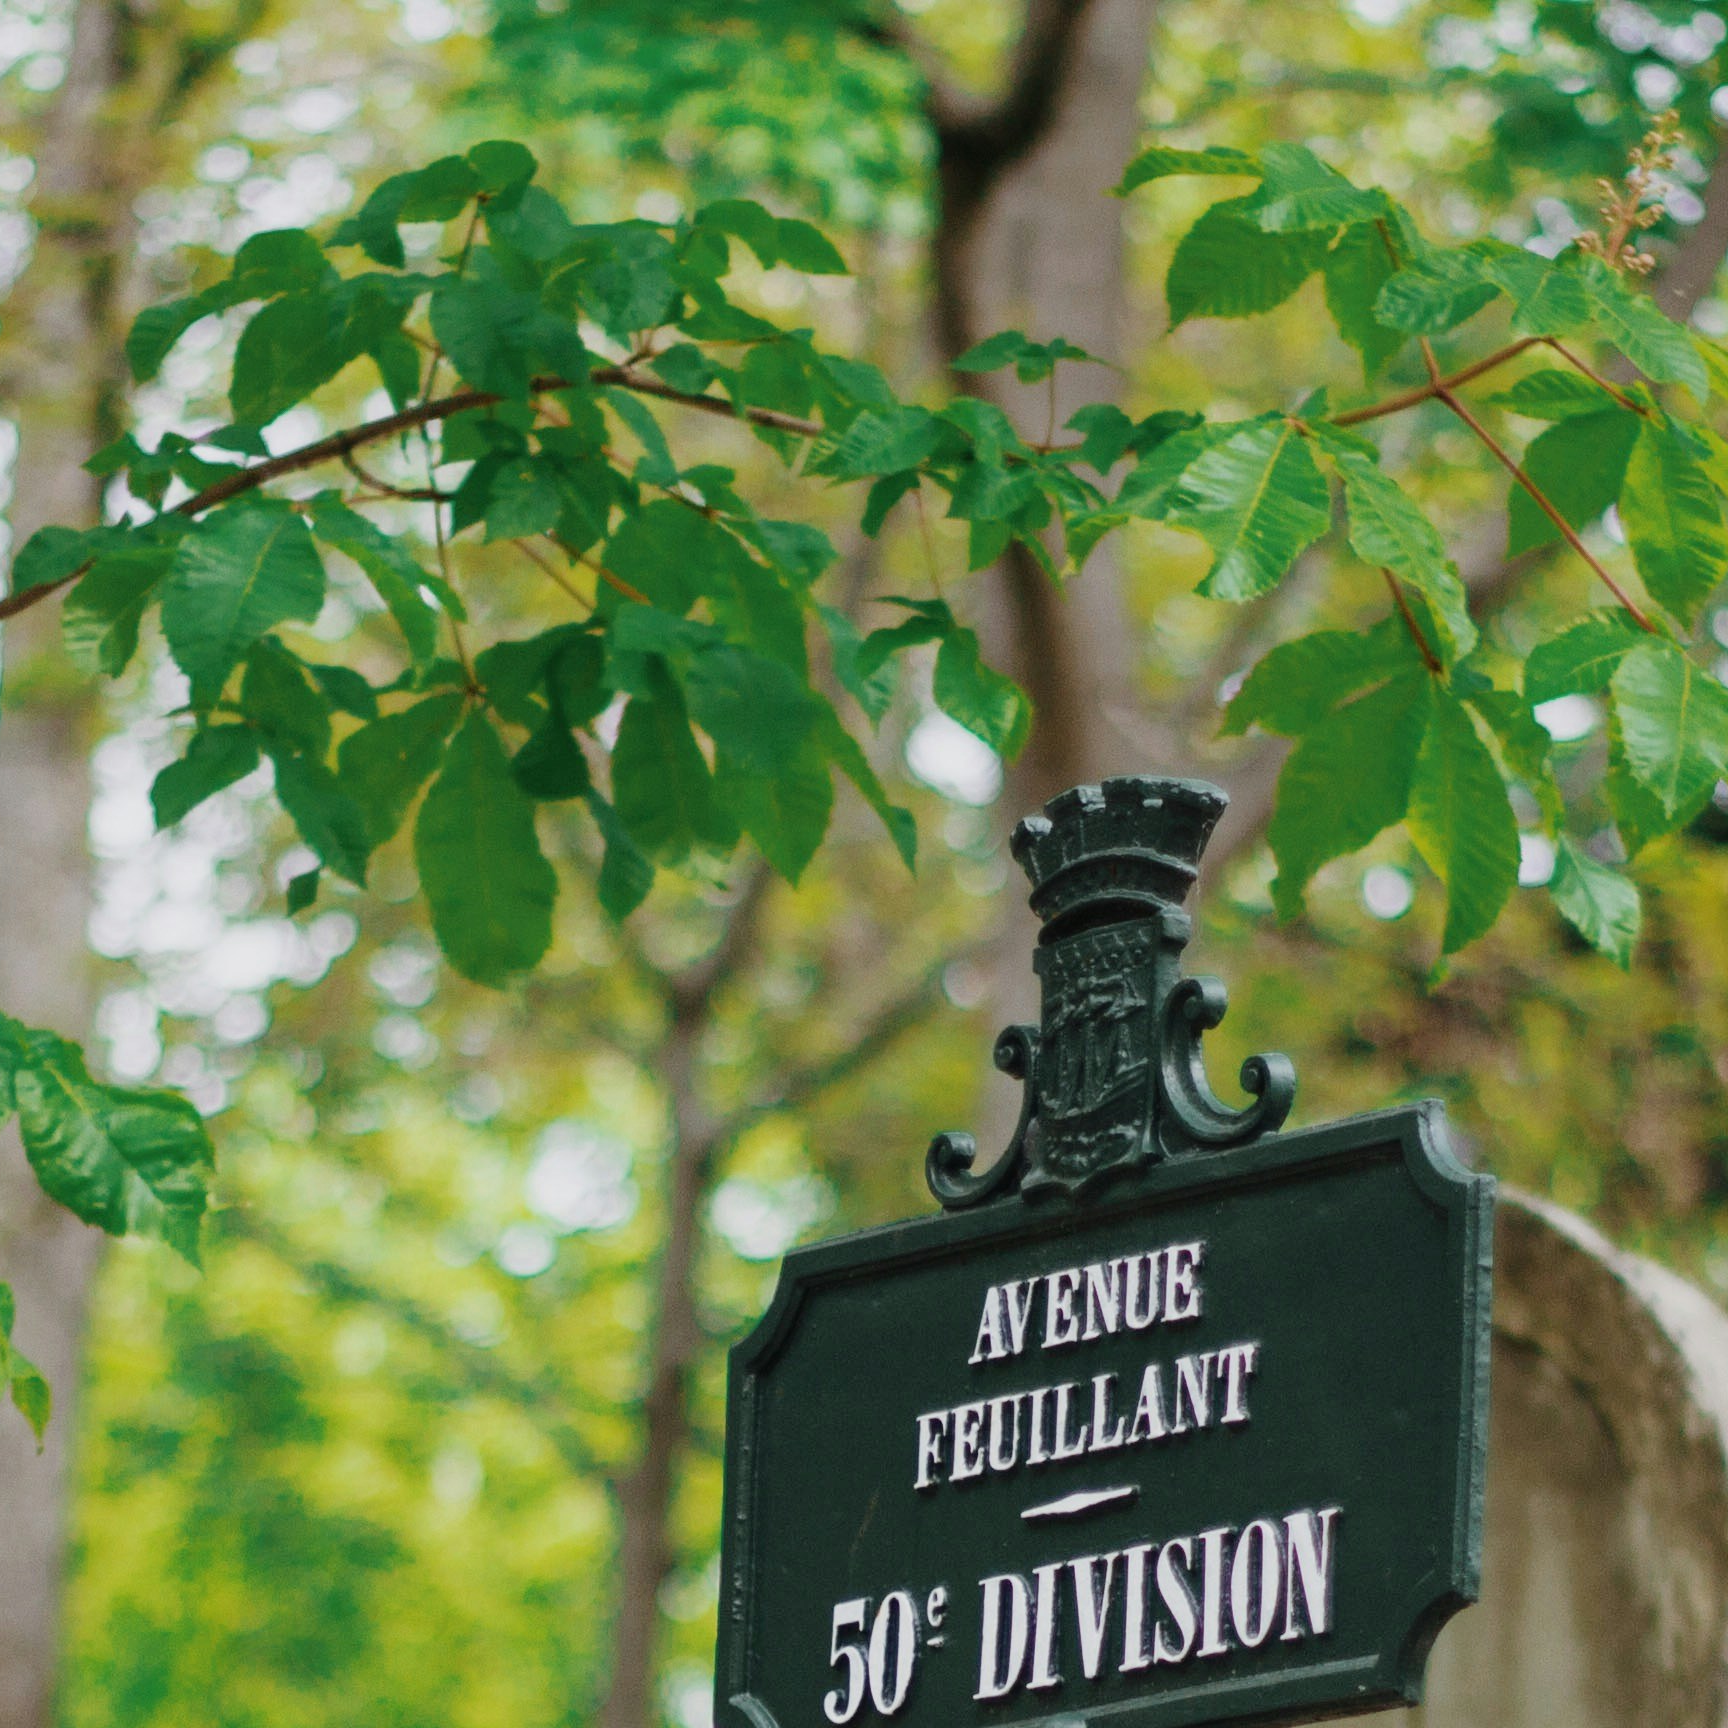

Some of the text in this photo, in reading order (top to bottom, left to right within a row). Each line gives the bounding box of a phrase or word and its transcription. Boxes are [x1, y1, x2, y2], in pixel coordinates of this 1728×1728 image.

[967, 1240, 1207, 1364] AVENUE
[913, 1341, 1260, 1490] FEUILLANT
[972, 1506, 1343, 1700] DIVISION
